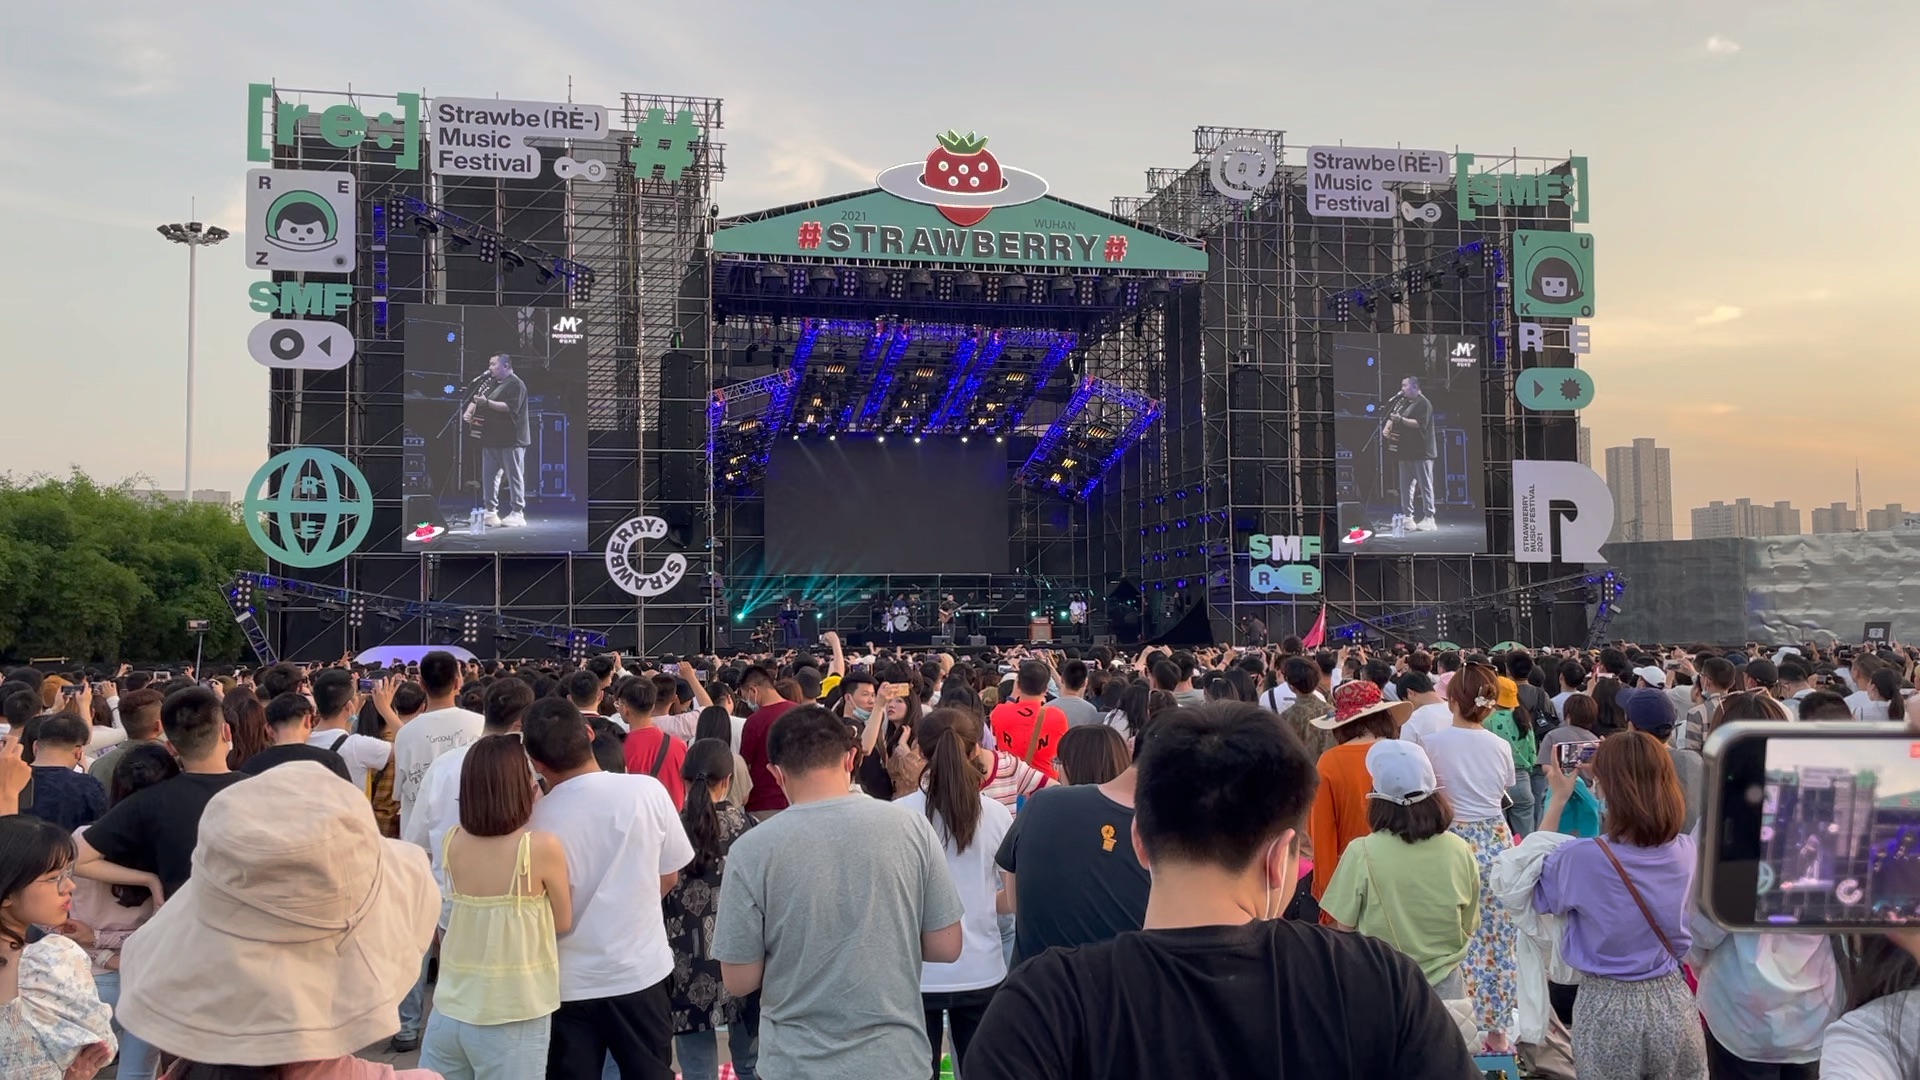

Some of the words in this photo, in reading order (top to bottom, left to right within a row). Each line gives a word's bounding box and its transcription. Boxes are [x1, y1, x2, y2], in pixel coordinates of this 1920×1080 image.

[438, 127, 512, 149] Music
[438, 150, 532, 173] Festival
[258, 176, 271, 189] R
[337, 180, 349, 194] E
[1314, 173, 1373, 191] Music
[1315, 193, 1390, 213] Festival
[841, 210, 867, 221] 2021
[1034, 218, 1076, 230] WUHAN
[1519, 235, 1529, 246] Y
[1580, 237, 1589, 249] U
[256, 252, 268, 265] Z
[248, 281, 353, 316] SMF
[1520, 302, 1530, 314] K
[1518, 322, 1543, 352] R
[1569, 325, 1590, 353] E
[301, 476, 318, 494] R
[300, 521, 316, 538] E
[1249, 534, 1320, 561] SMF
[1258, 571, 1271, 586] R
[1302, 571, 1313, 586] E
